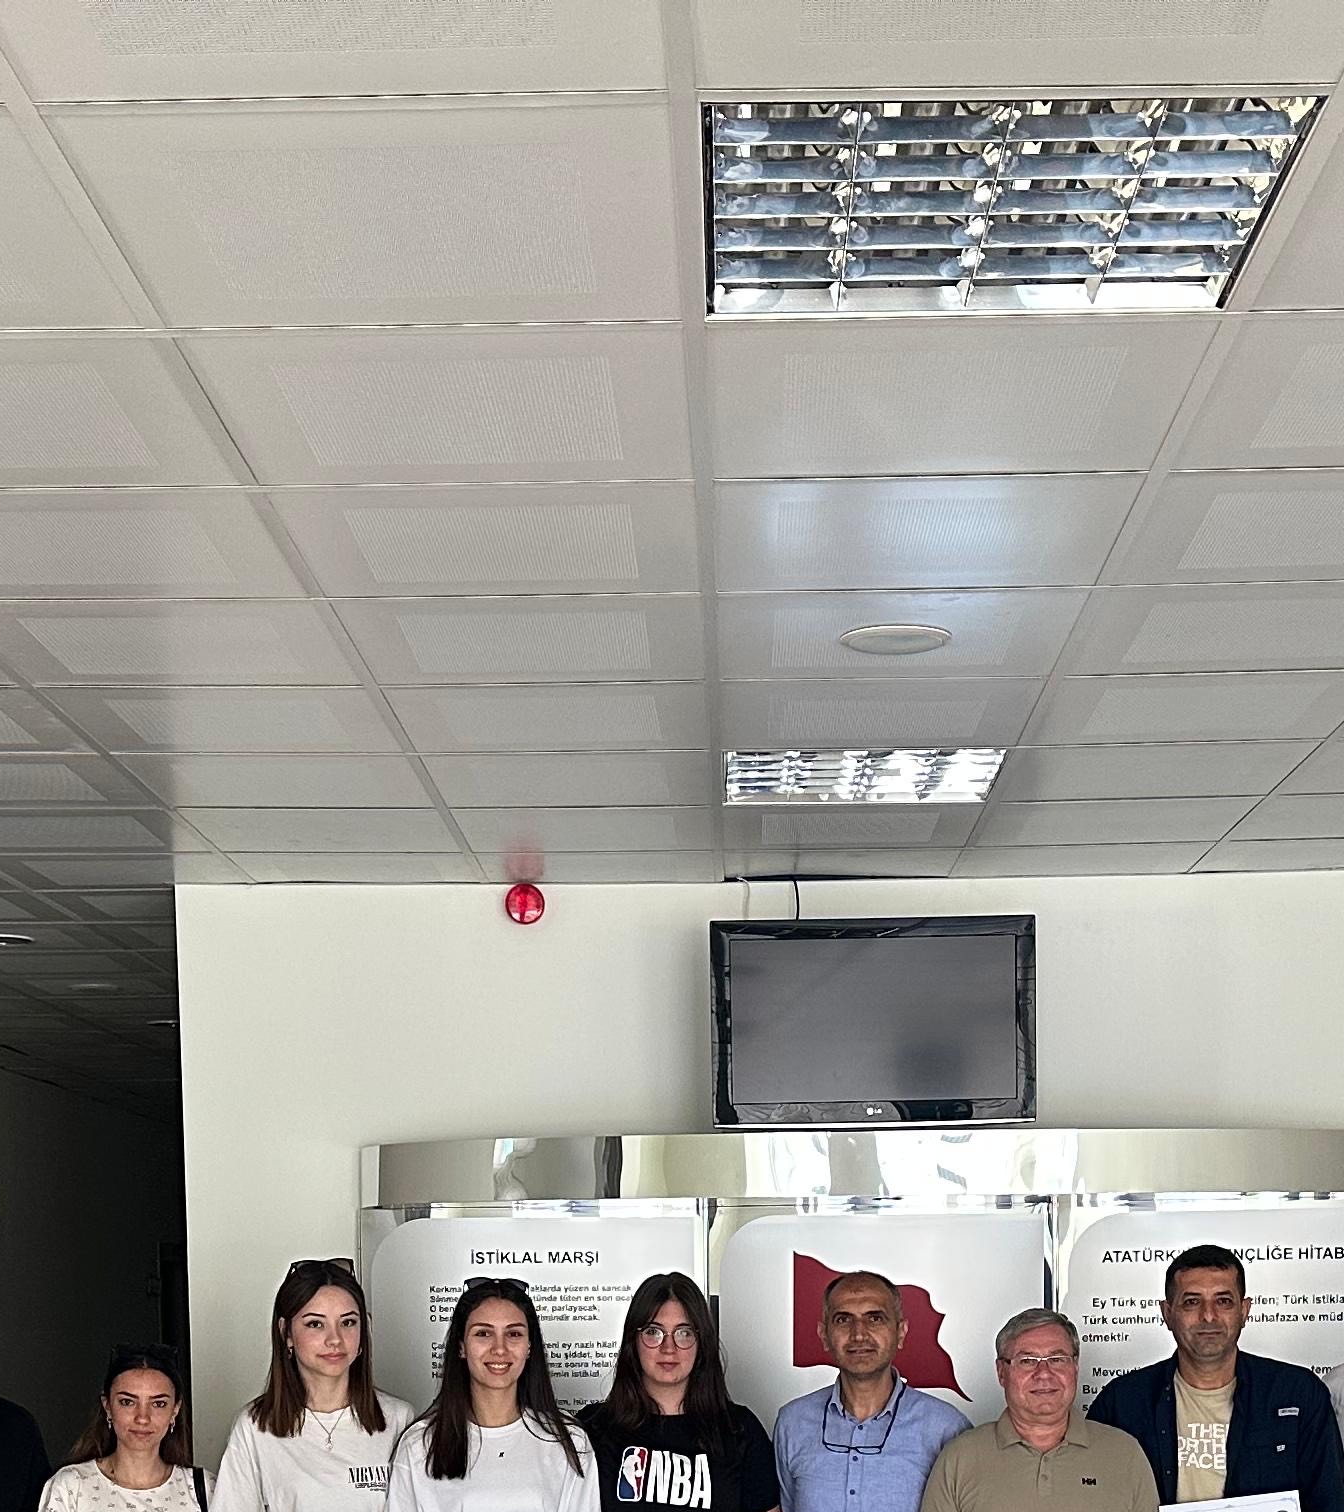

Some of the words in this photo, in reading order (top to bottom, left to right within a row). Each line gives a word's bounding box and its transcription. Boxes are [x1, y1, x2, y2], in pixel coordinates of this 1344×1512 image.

[470, 1248, 543, 1264] İSTİKLAL
[548, 1251, 600, 1267] MARŞI
[1102, 1247, 1182, 1263] ATATÜRK'
[1234, 1245, 1294, 1264] NÇLİĞE
[530, 1284, 562, 1292] aklarda
[564, 1284, 590, 1293] yüzen
[429, 1295, 459, 1303] Sönme
[532, 1294, 558, 1302] tünde
[1092, 1298, 1106, 1309] Ey
[1110, 1297, 1136, 1308] Türk
[1282, 1294, 1309, 1304] Türk
[1082, 1314, 1108, 1325] Türk
[1112, 1314, 1166, 1326] cumhuriy
[1302, 1314, 1316, 1322] ve
[562, 1342, 572, 1350] ey
[1082, 1384, 1098, 1395] Bu
[1188, 1422, 1225, 1439] THE
[1178, 1436, 1226, 1455] ORTH
[1178, 1450, 1226, 1470] FACE
[646, 1450, 712, 1510] NBA
